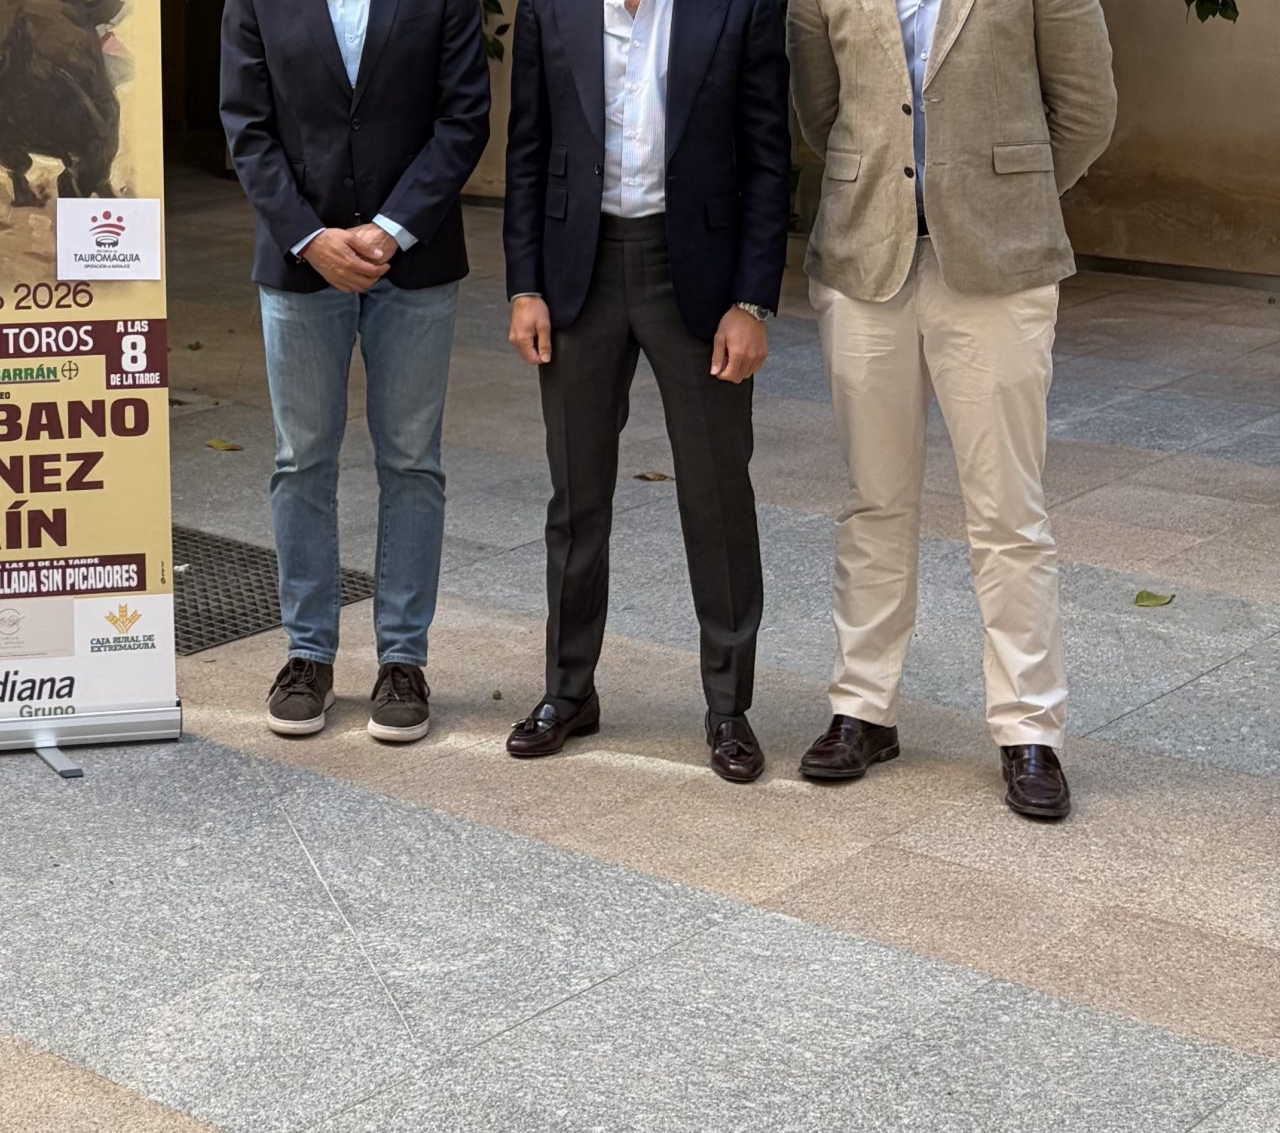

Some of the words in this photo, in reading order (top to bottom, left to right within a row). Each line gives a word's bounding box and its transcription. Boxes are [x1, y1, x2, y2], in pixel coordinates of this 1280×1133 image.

[13, 281, 94, 311] 2026
[116, 321, 125, 333] A
[127, 320, 149, 332] LAS
[3, 325, 94, 354] TOROS
[121, 334, 147, 372] 8
[110, 373, 121, 386] DE
[123, 373, 133, 385] LA
[134, 372, 160, 385] TARDE
[40, 568, 63, 593] SIN
[65, 564, 138, 591] PICADORES
[90, 637, 111, 645] CAJA
[112, 635, 141, 643] RURAL
[142, 634, 155, 642] DE
[90, 643, 156, 653] EXTREMADURA
